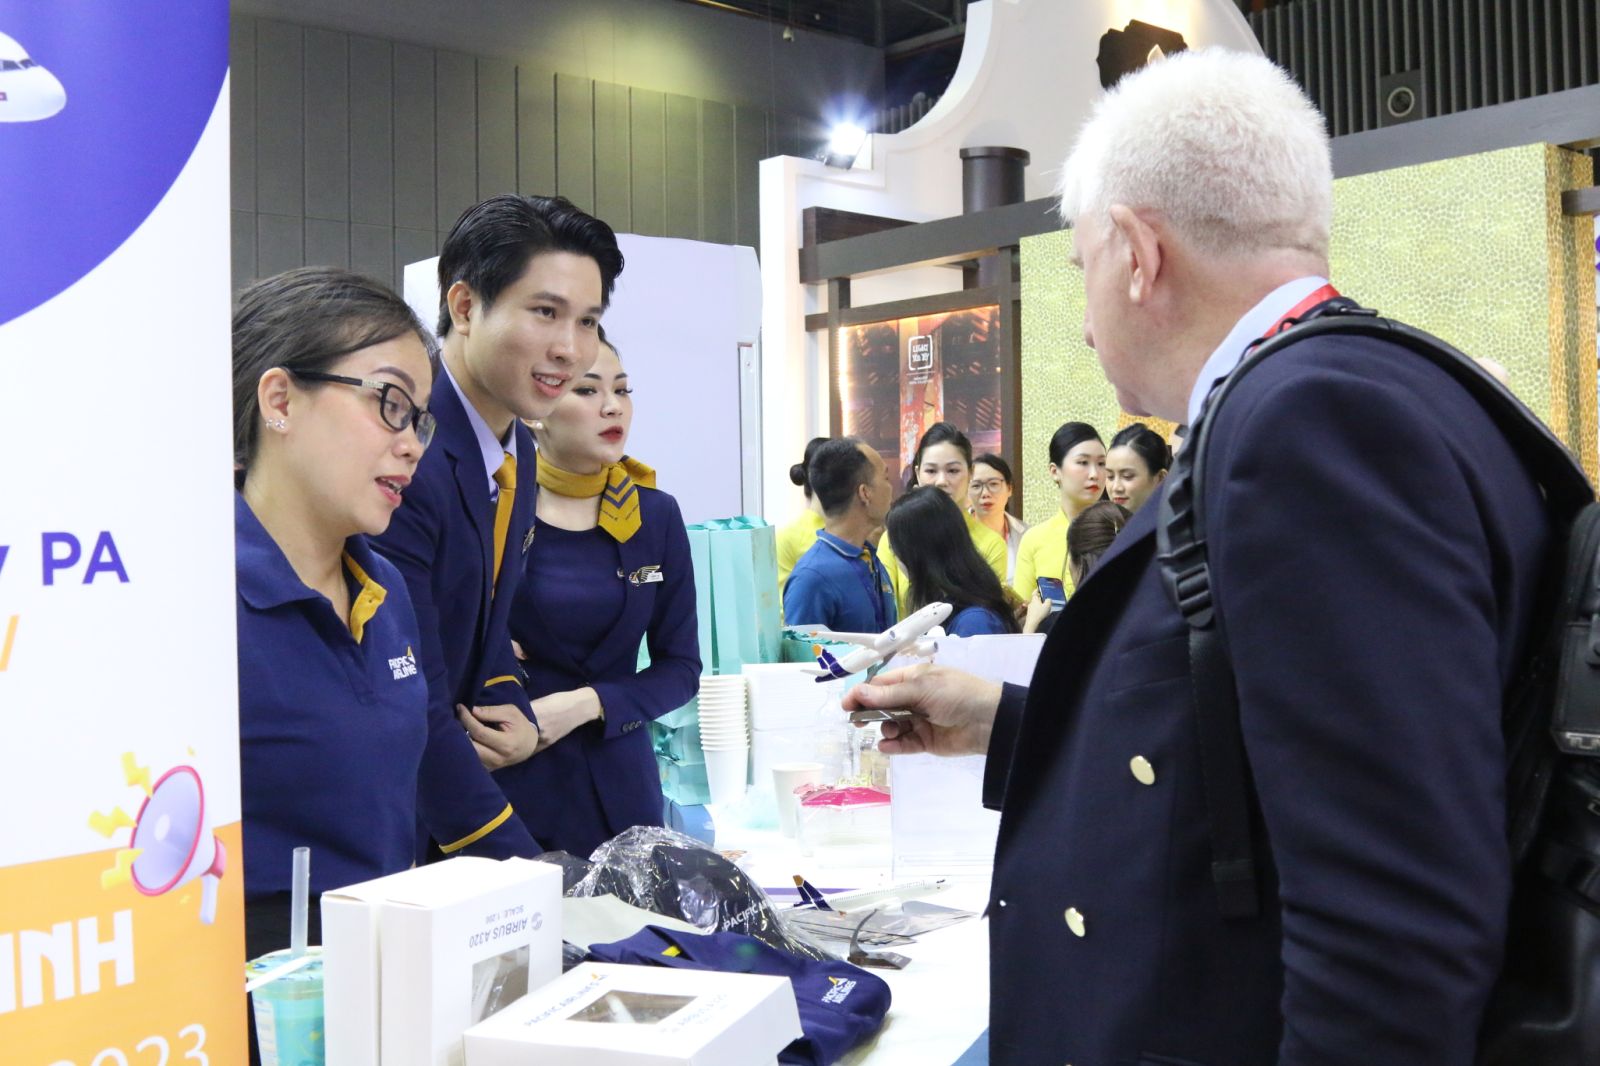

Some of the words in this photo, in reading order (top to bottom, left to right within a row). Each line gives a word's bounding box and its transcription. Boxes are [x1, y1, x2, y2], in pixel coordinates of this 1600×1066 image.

[42, 531, 130, 586] PA
[493, 918, 527, 939] AIRBUS
[723, 903, 758, 931] PACIFIC
[469, 930, 491, 948] A320
